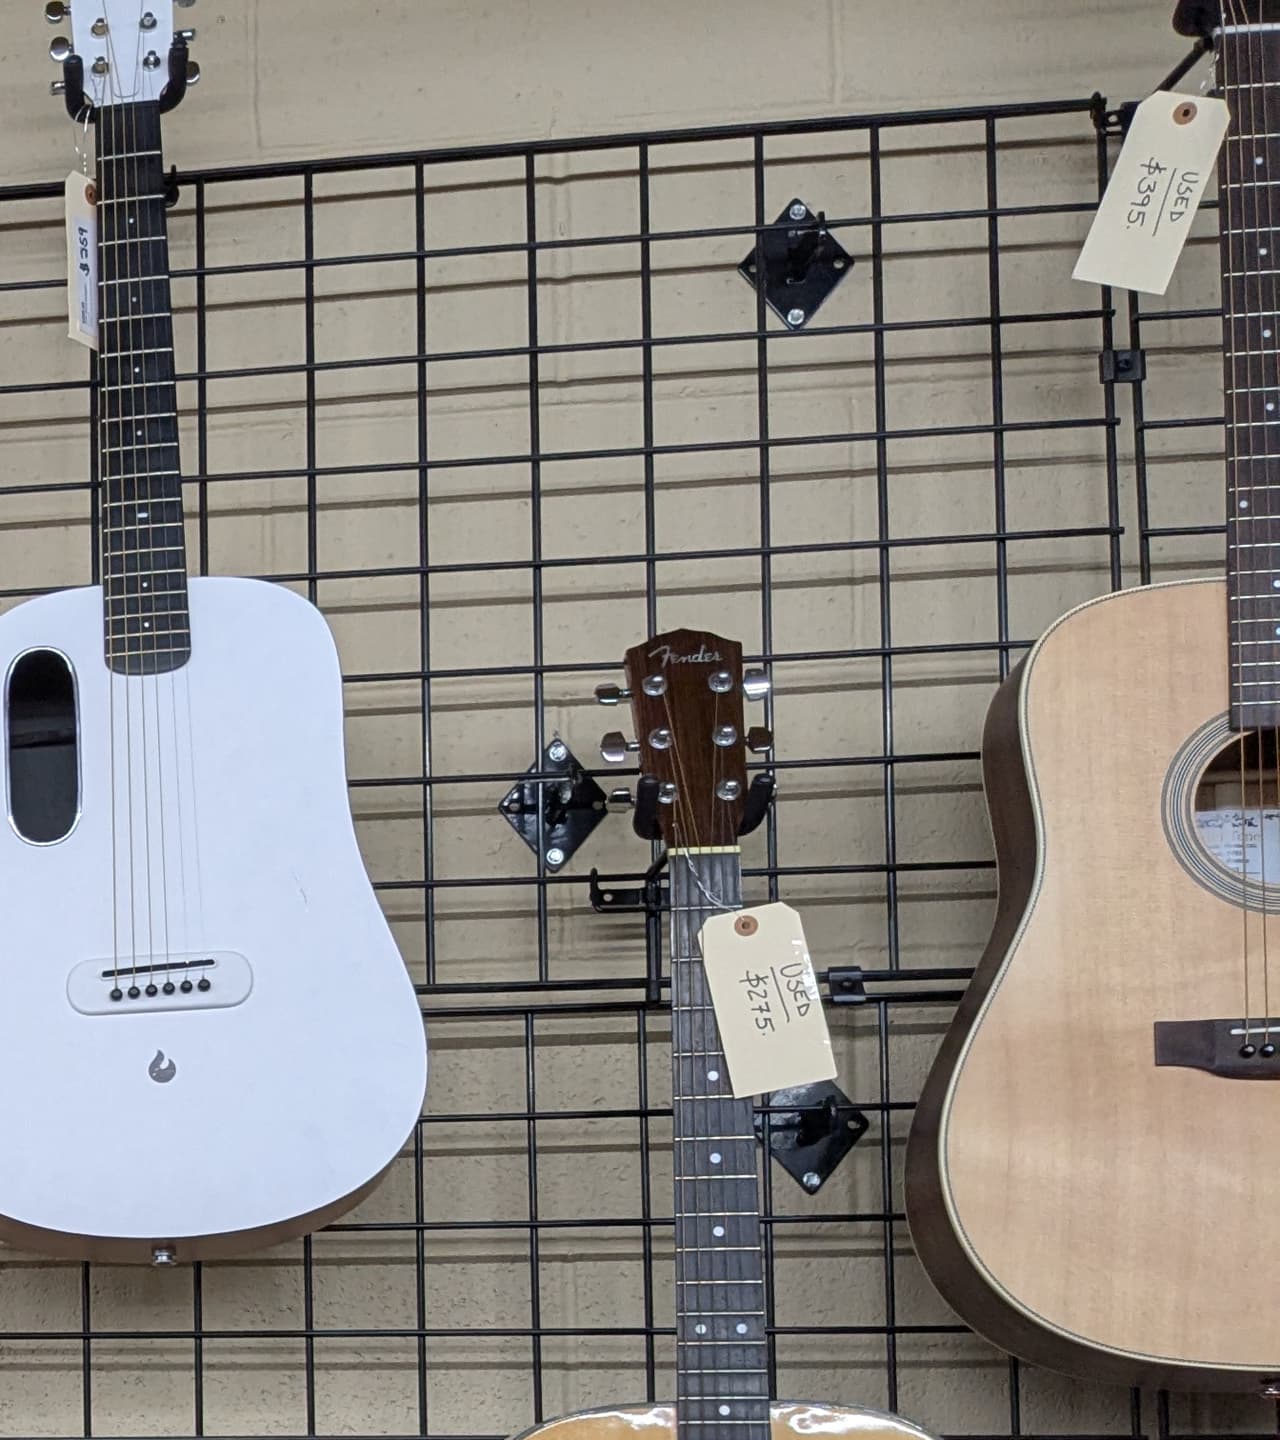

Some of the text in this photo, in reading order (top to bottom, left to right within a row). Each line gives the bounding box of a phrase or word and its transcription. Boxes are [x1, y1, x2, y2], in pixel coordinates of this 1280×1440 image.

[1170, 172, 1200, 222] USED
[648, 644, 724, 669] Fender
[780, 963, 810, 1017] USED
